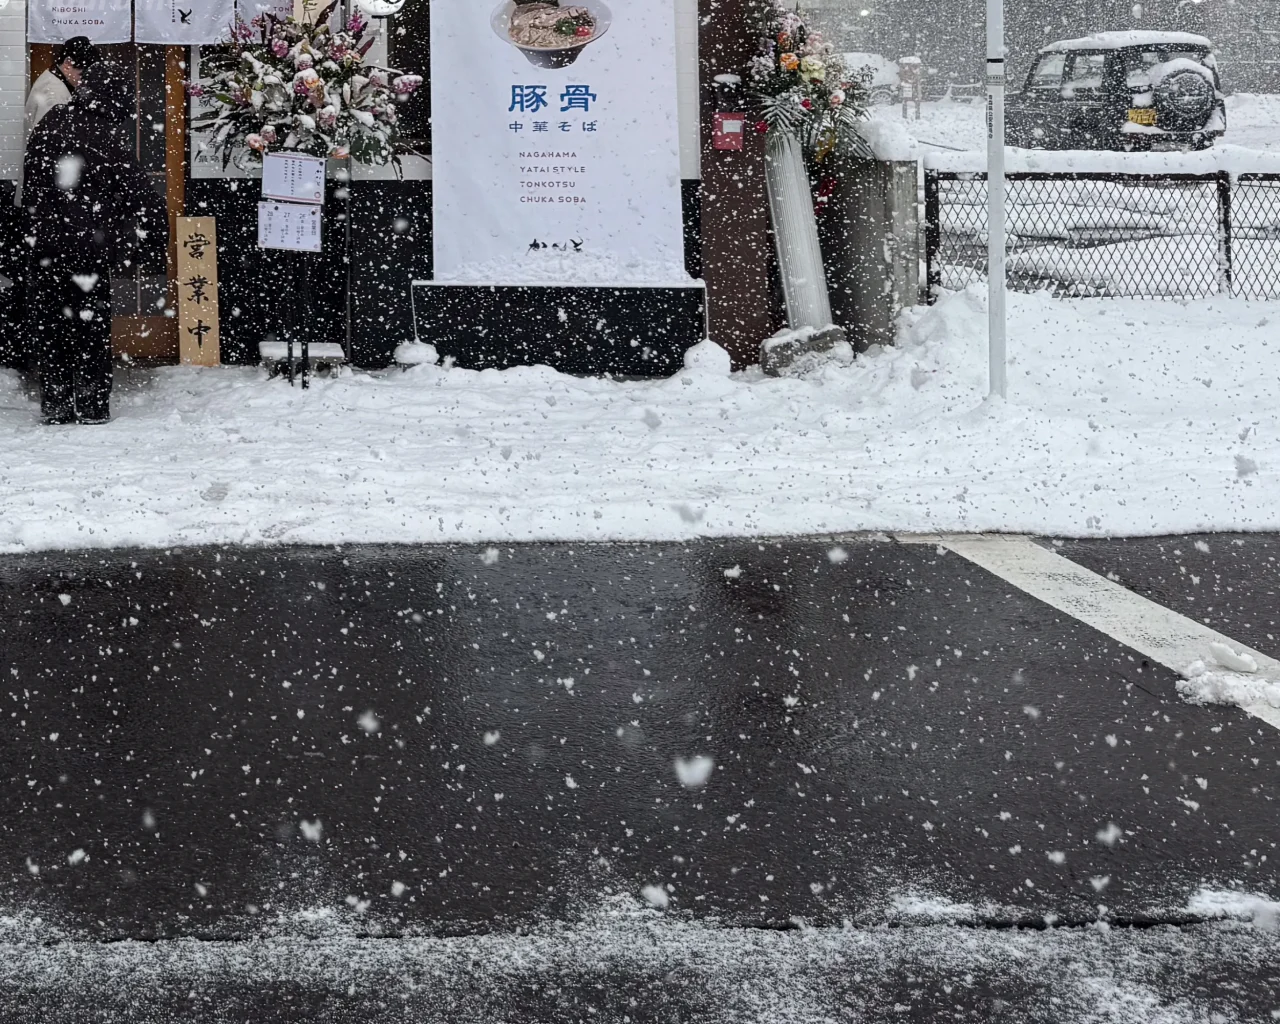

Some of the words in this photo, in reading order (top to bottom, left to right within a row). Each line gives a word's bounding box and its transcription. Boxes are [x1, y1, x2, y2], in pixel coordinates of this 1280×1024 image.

[508, 84, 597, 113] 豚骨
[509, 120, 598, 133] 中華そば
[183, 232, 214, 349] 営業中
